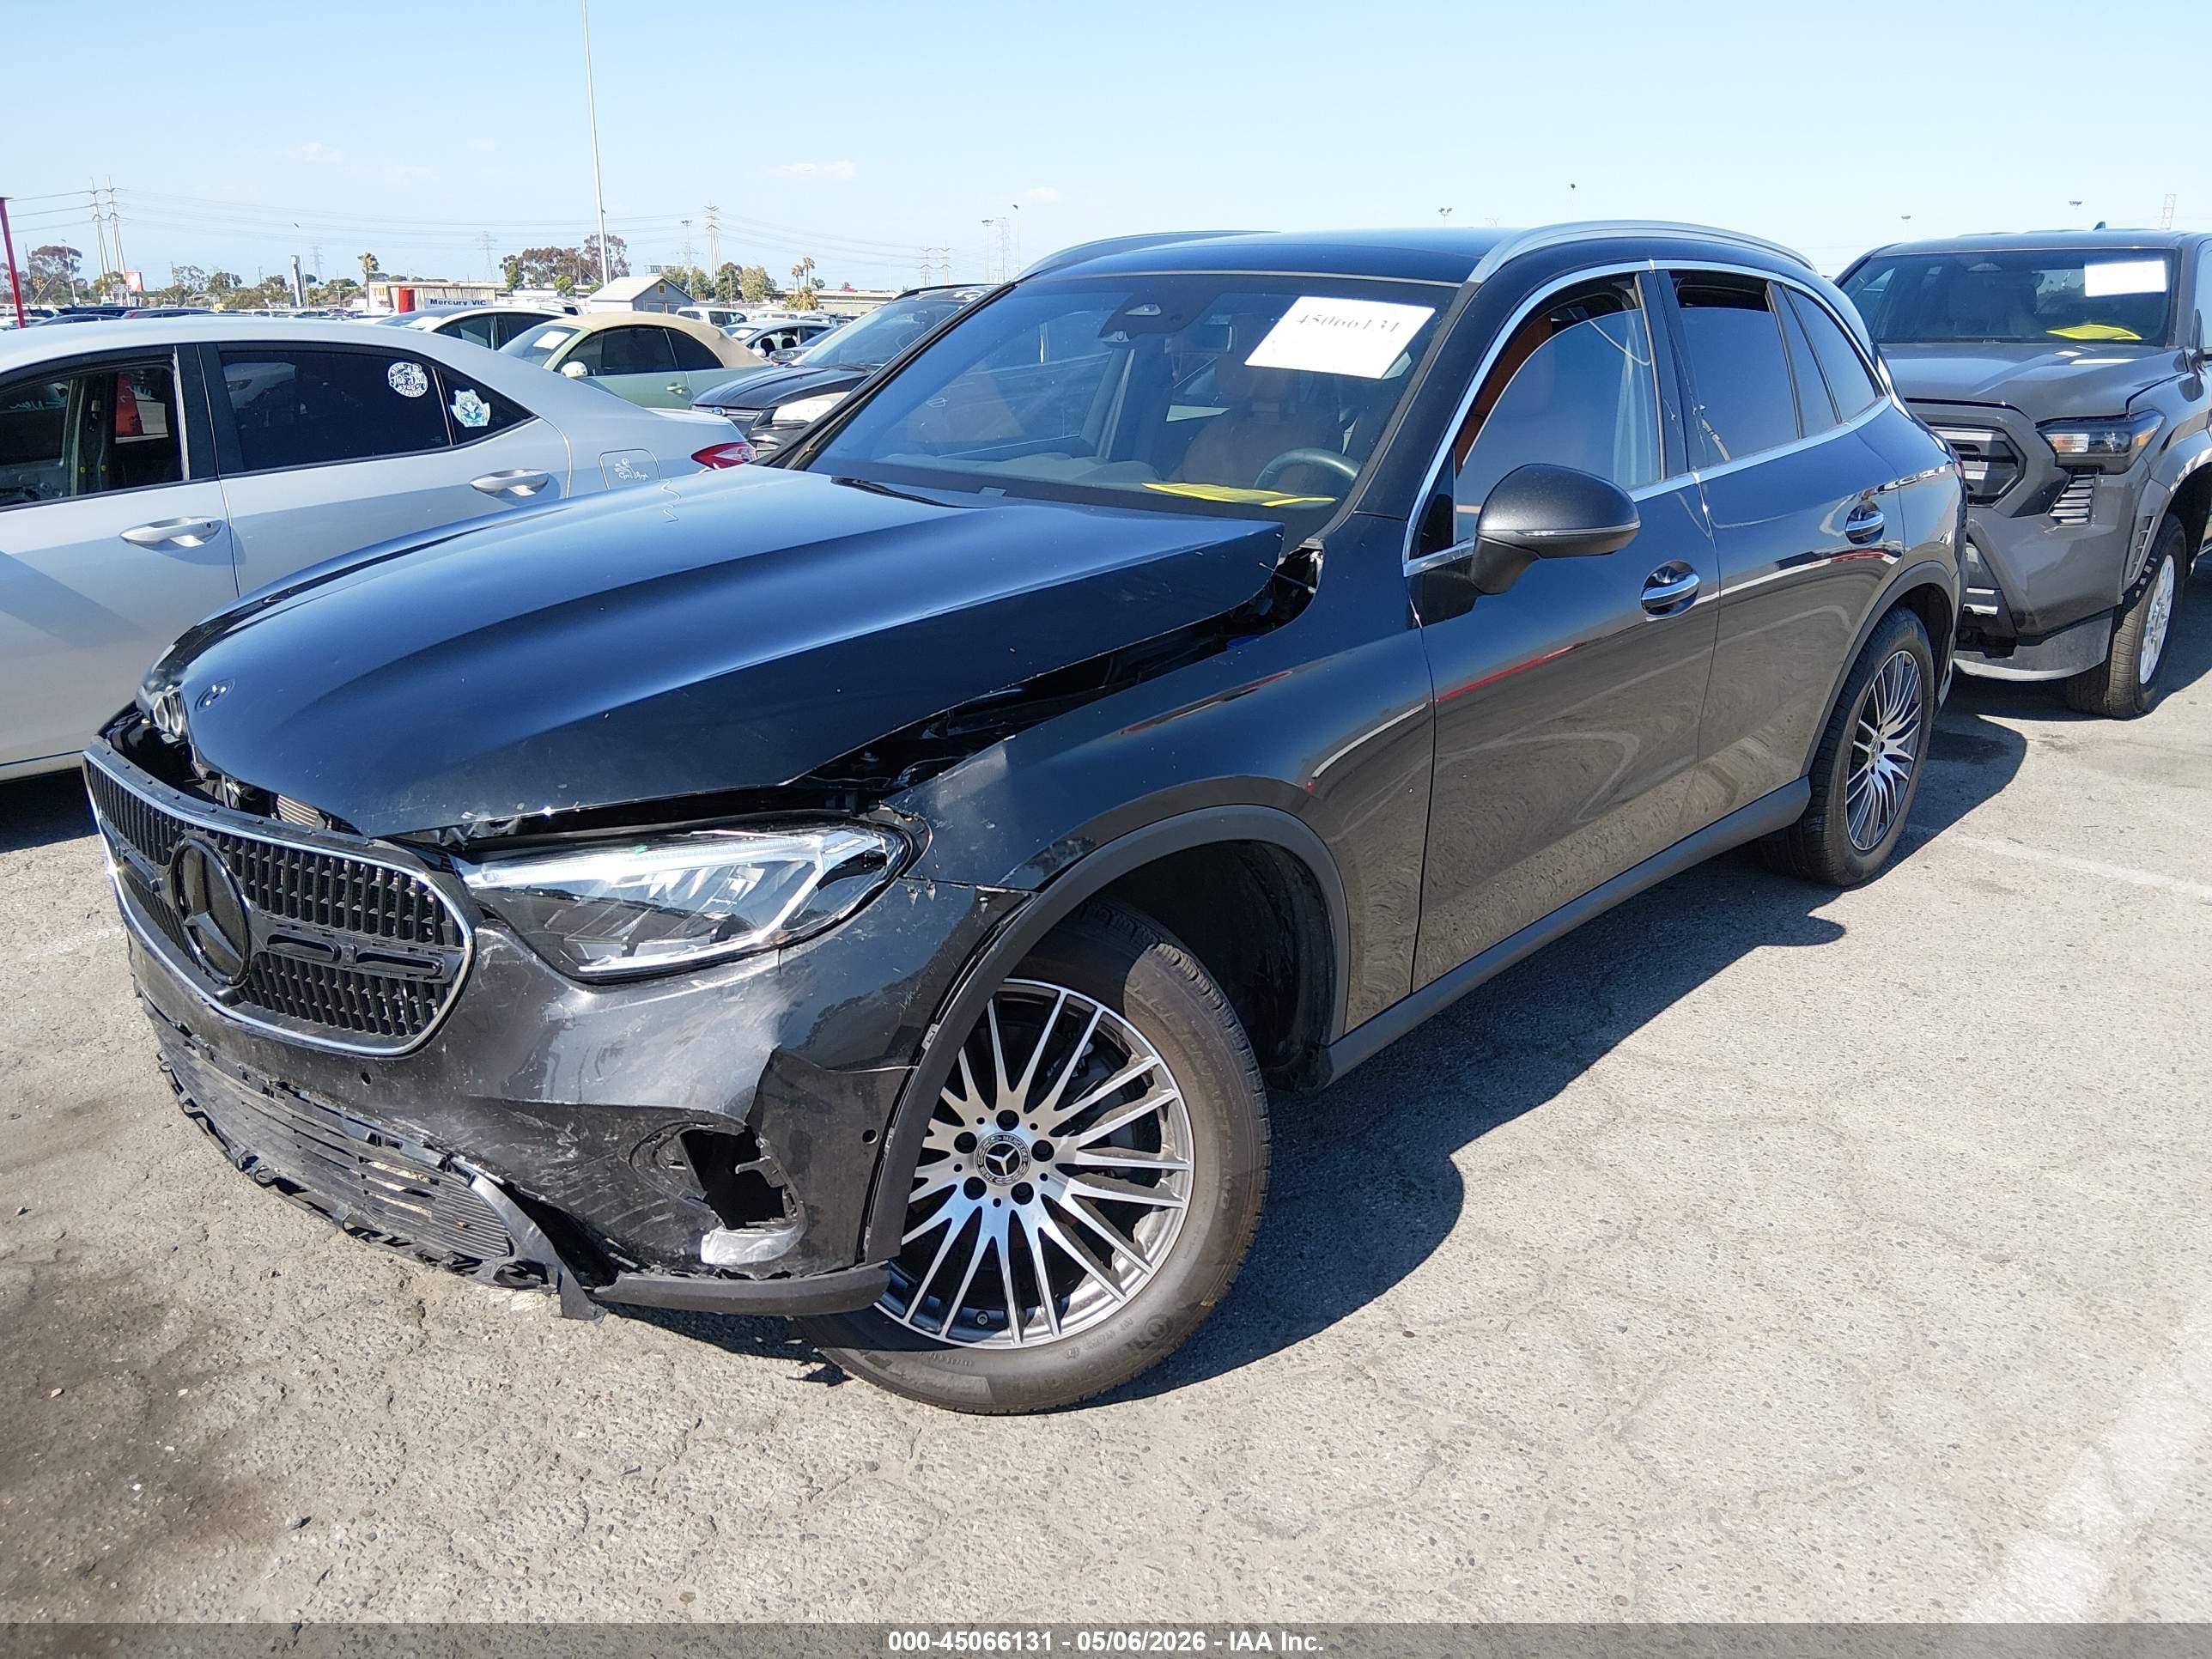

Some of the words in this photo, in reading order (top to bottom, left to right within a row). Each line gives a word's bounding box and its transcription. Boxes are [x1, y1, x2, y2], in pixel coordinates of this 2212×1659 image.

[430, 298, 468, 307] Mercury
[1002, 1134, 1028, 1162] MERCEDES
[979, 1166, 995, 1182] BENZ
